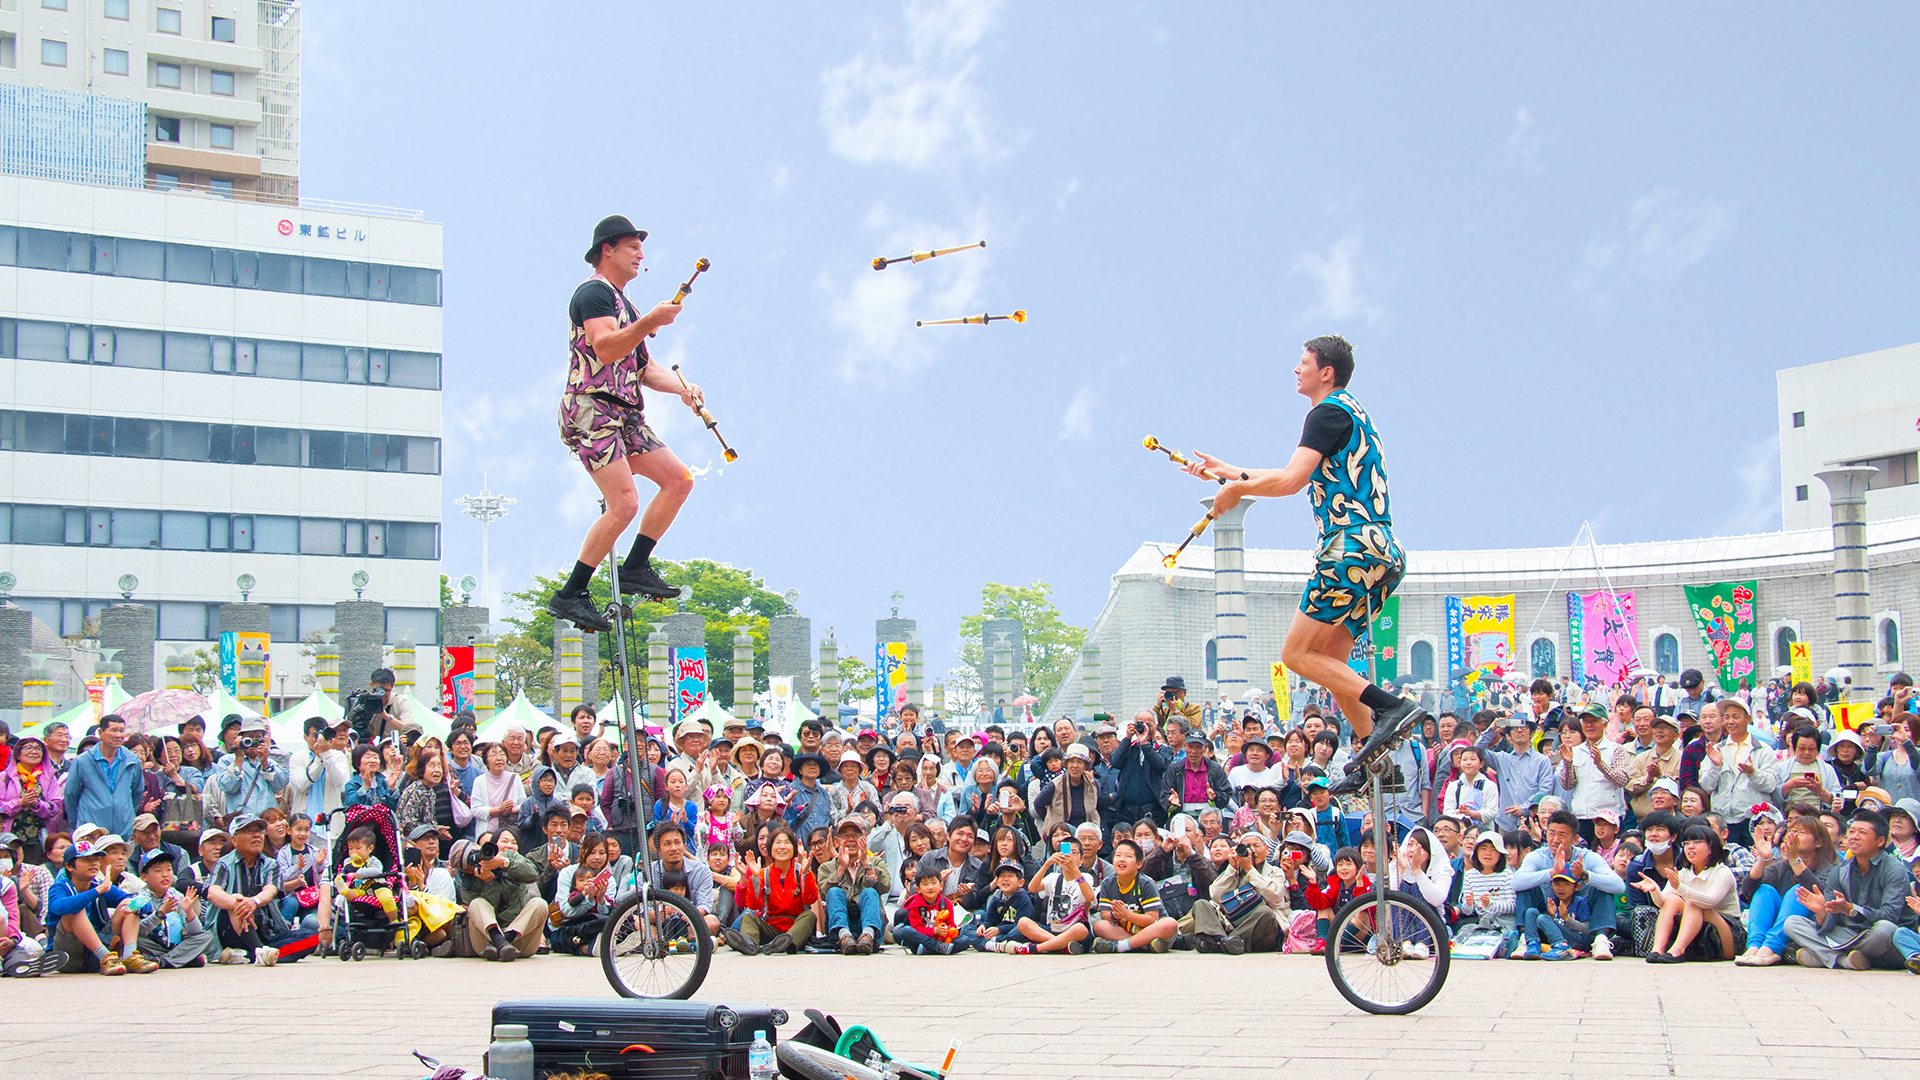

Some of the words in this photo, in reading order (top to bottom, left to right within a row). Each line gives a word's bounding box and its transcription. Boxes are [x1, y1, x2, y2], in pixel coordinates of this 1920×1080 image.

[299, 224, 366, 241] 東鉱ビル
[1461, 604, 1510, 624] 勝栄丸
